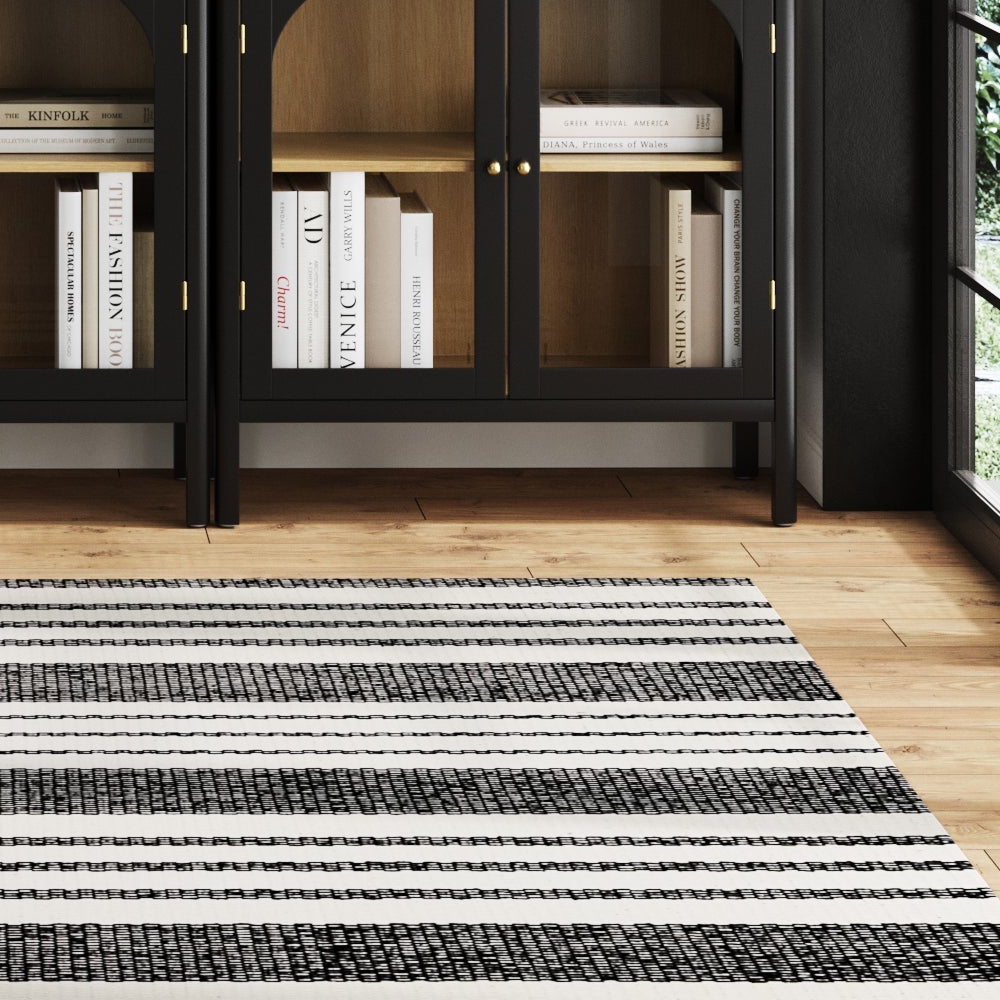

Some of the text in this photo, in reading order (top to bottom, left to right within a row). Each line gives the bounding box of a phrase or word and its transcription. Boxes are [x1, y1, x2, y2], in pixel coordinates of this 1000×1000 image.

[28, 111, 90, 121] KINFOLK
[543, 141, 578, 149] DIANA,
[109, 183, 123, 226] THE
[304, 207, 323, 244] AD
[109, 232, 123, 320] FASHION
[340, 190, 356, 368] VENICE GARRY WILLS
[675, 255, 686, 302] SHOW
[277, 276, 290, 329] Charm!
[412, 276, 421, 365] HENRI ROUSSEAU
